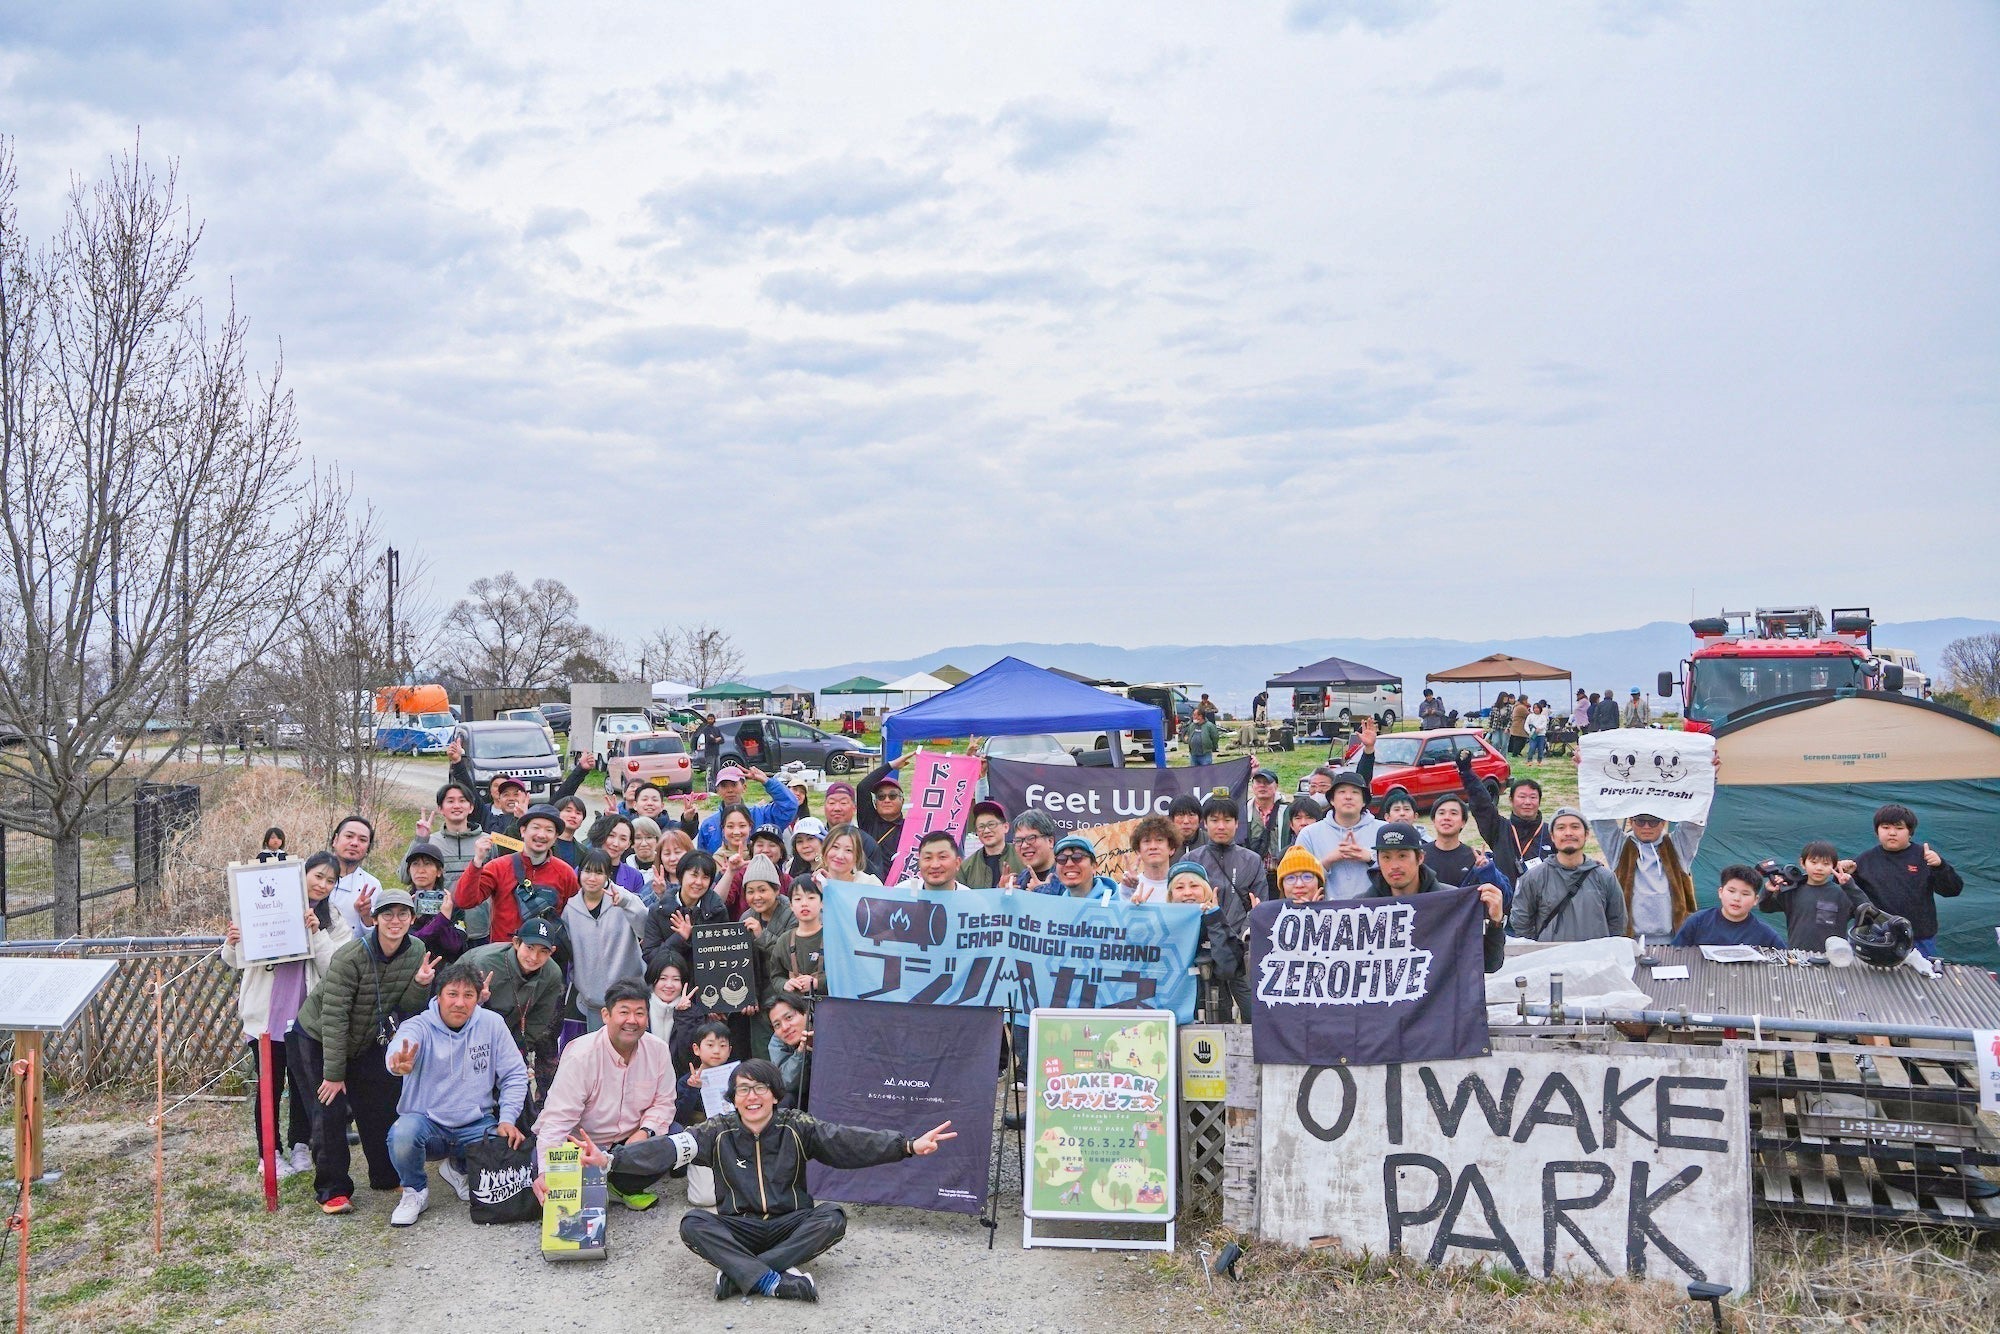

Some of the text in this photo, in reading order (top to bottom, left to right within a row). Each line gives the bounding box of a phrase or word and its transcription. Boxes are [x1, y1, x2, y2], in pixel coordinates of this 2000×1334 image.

[1025, 784, 1214, 816] Feet Wok
[255, 900, 284, 910] Water Lily
[957, 912, 1127, 940] Tetsu de tsukuru
[1278, 910, 1408, 951] OMAME
[697, 928, 744, 938] 自然な暮らし
[957, 930, 1161, 962] CAMP DOUGU no BRAND
[697, 958, 750, 970] コリコック
[1262, 956, 1427, 998] ZEROFIVE
[469, 1043, 490, 1053] PEACE
[471, 1051, 490, 1060] GOAT
[898, 1080, 930, 1088] ANOBA
[1050, 1075, 1155, 1093] OIWAKE PARK
[1297, 1063, 1730, 1154] OIWAKE
[1059, 1137, 1136, 1148] 2026.3.22
[549, 1151, 578, 1161] RAPTOR
[548, 1189, 577, 1199] RAPTOR
[1384, 1152, 1709, 1282] PARK
